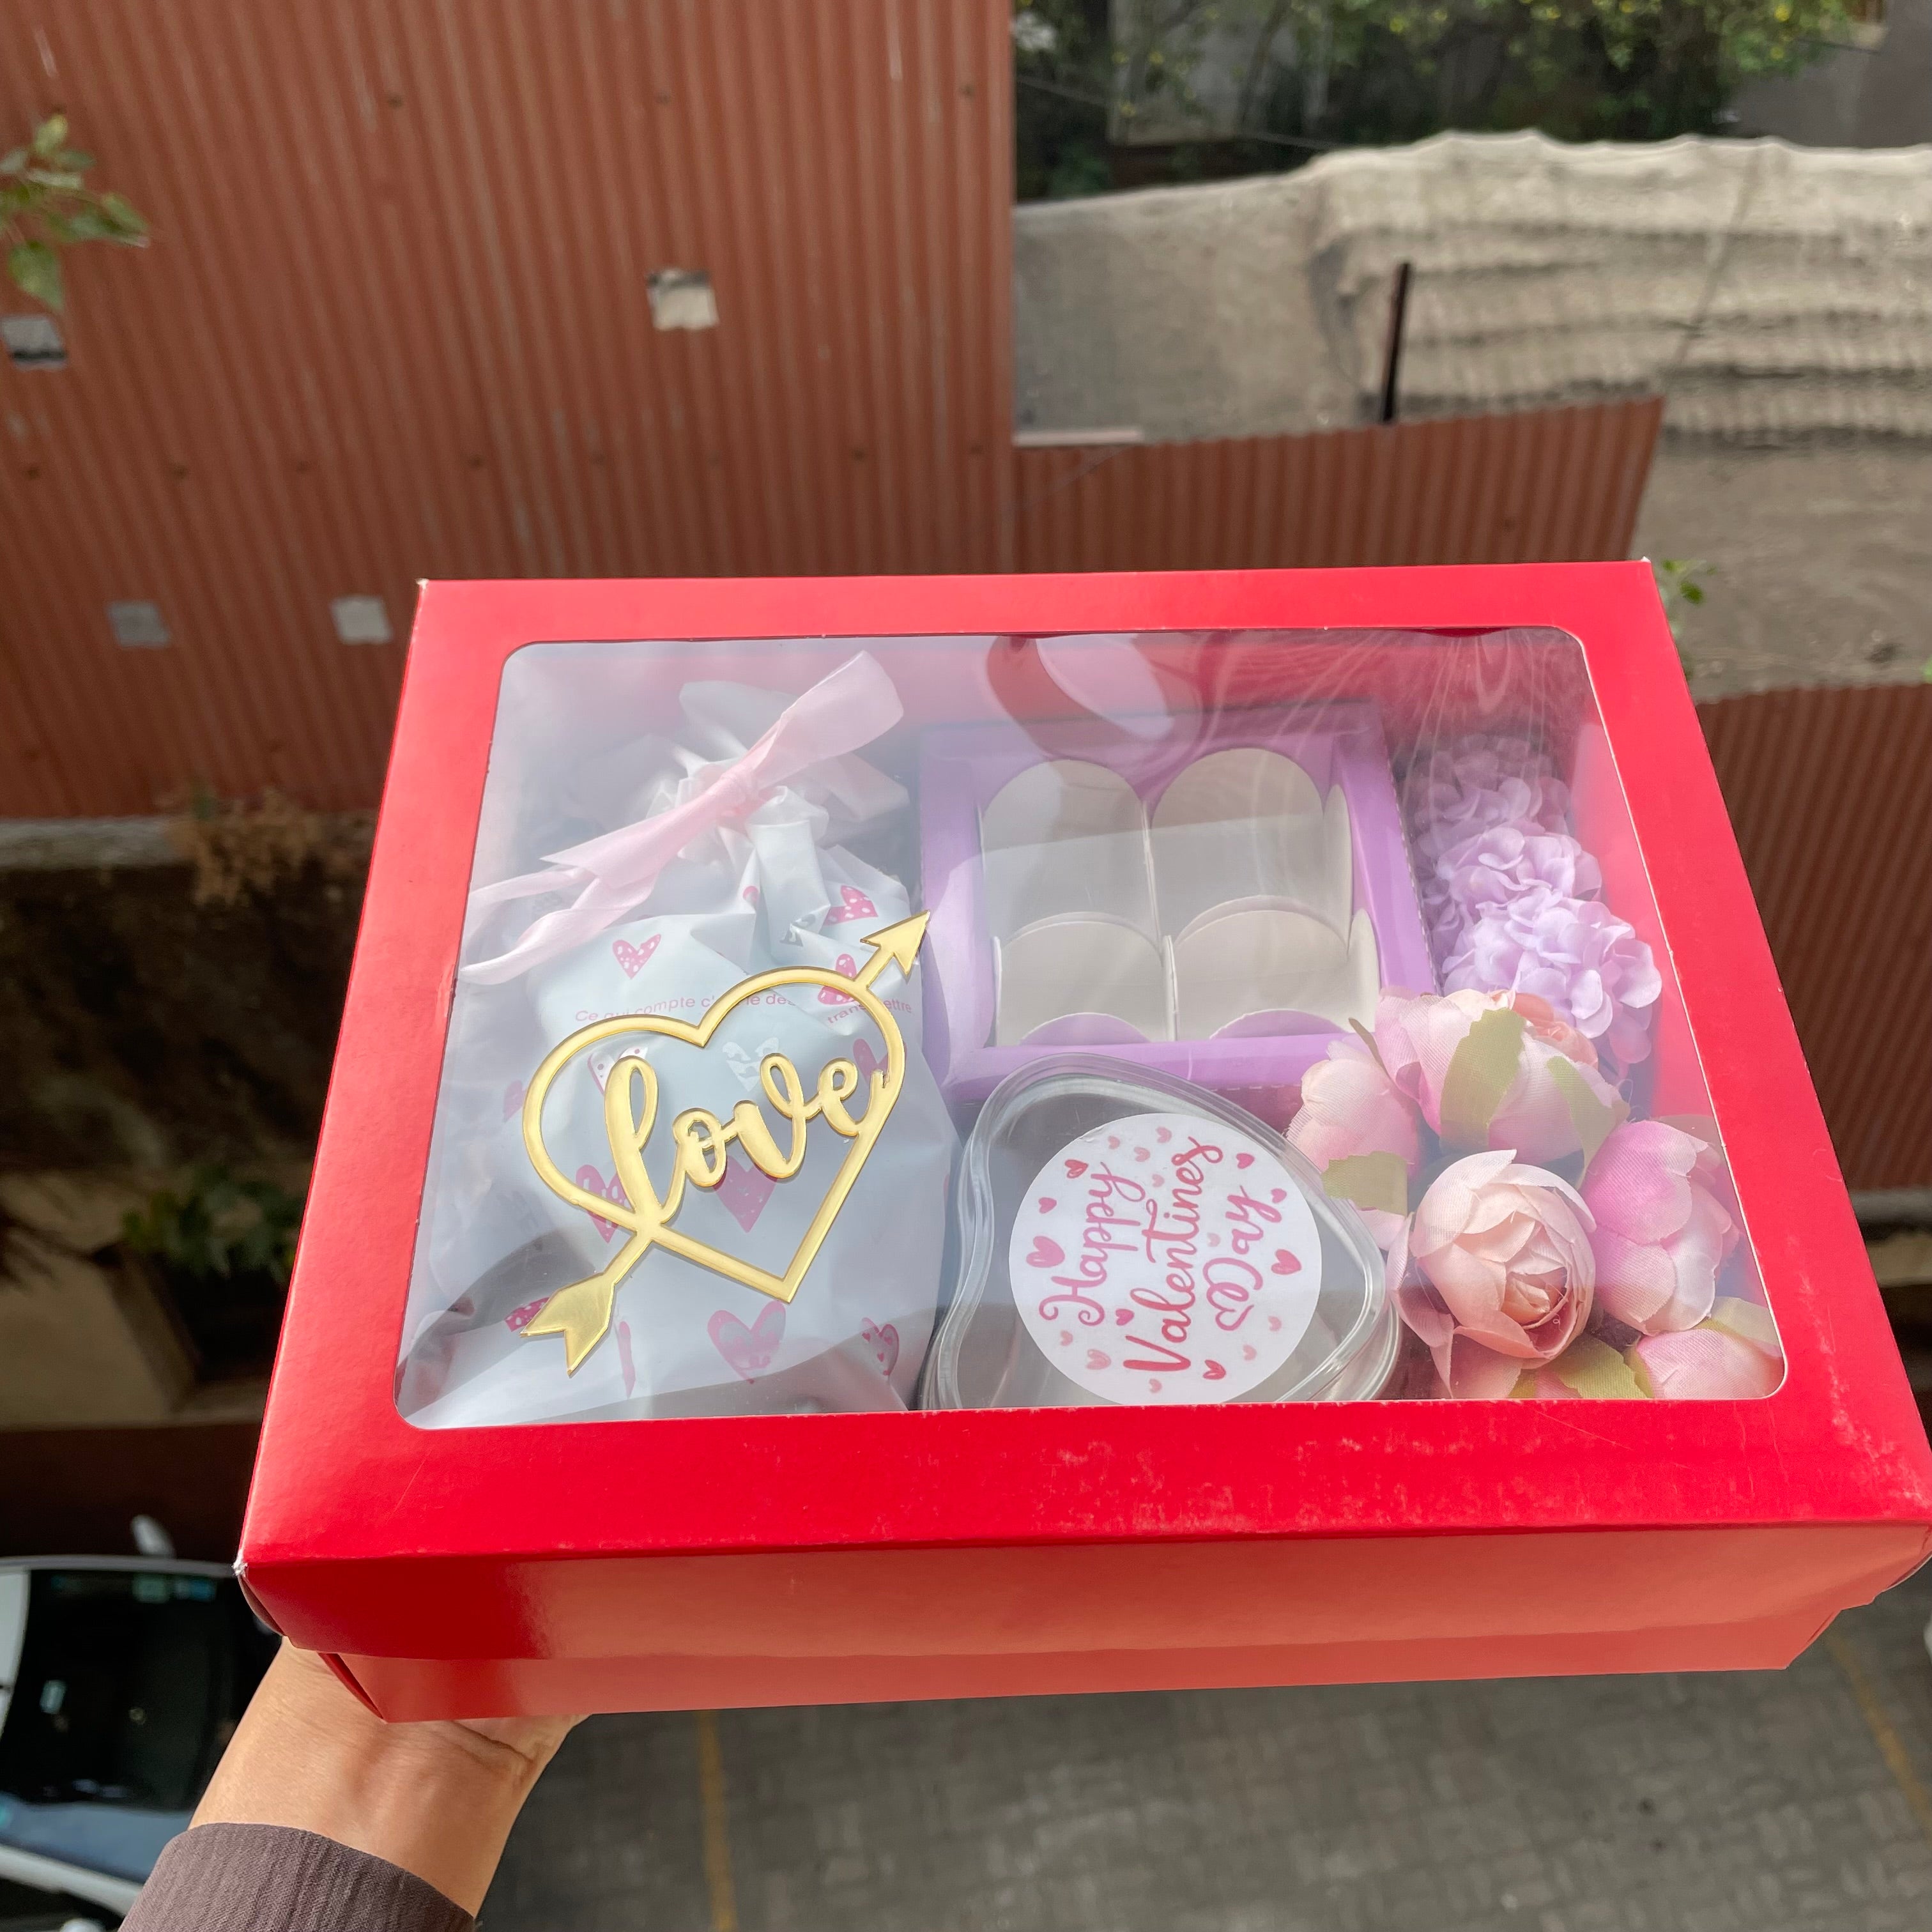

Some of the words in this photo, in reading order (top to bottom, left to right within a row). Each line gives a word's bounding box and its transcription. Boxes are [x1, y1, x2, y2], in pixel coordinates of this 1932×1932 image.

[827, 998, 912, 1023] transettre
[1039, 1162, 1146, 1326] Happy
[1123, 1136, 1223, 1373] Valentines
[1202, 1186, 1282, 1331] Day
